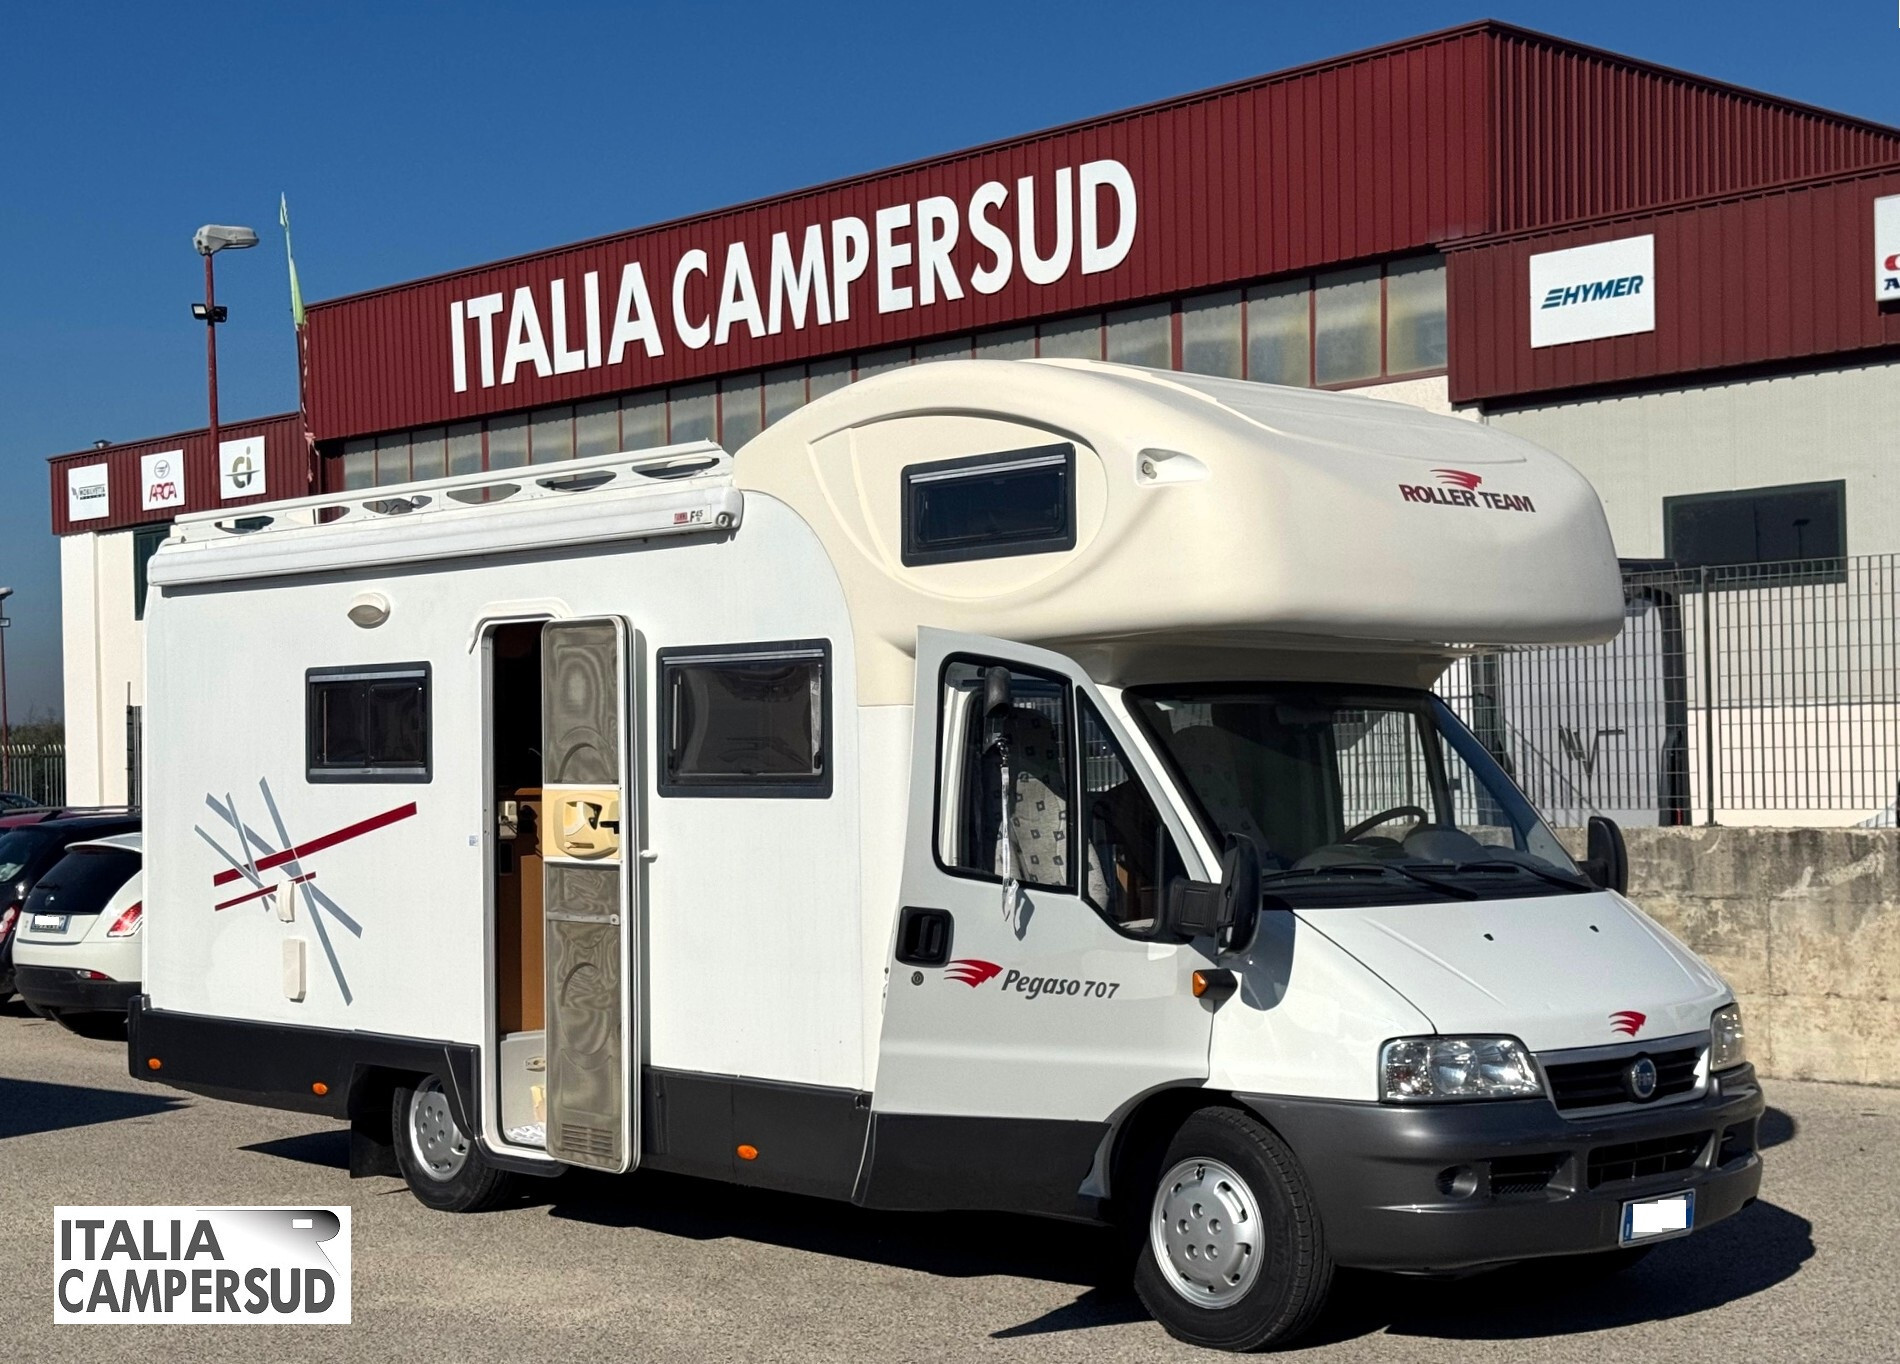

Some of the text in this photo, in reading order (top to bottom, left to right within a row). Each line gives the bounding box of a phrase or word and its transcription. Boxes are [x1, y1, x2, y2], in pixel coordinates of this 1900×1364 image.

[1561, 275, 1644, 306] HYMER
[451, 261, 665, 393] ITALIA
[149, 482, 178, 502] ARCA
[1399, 484, 1537, 513] ROLLER TEAM
[1001, 969, 1120, 1000] Pegaso 707
